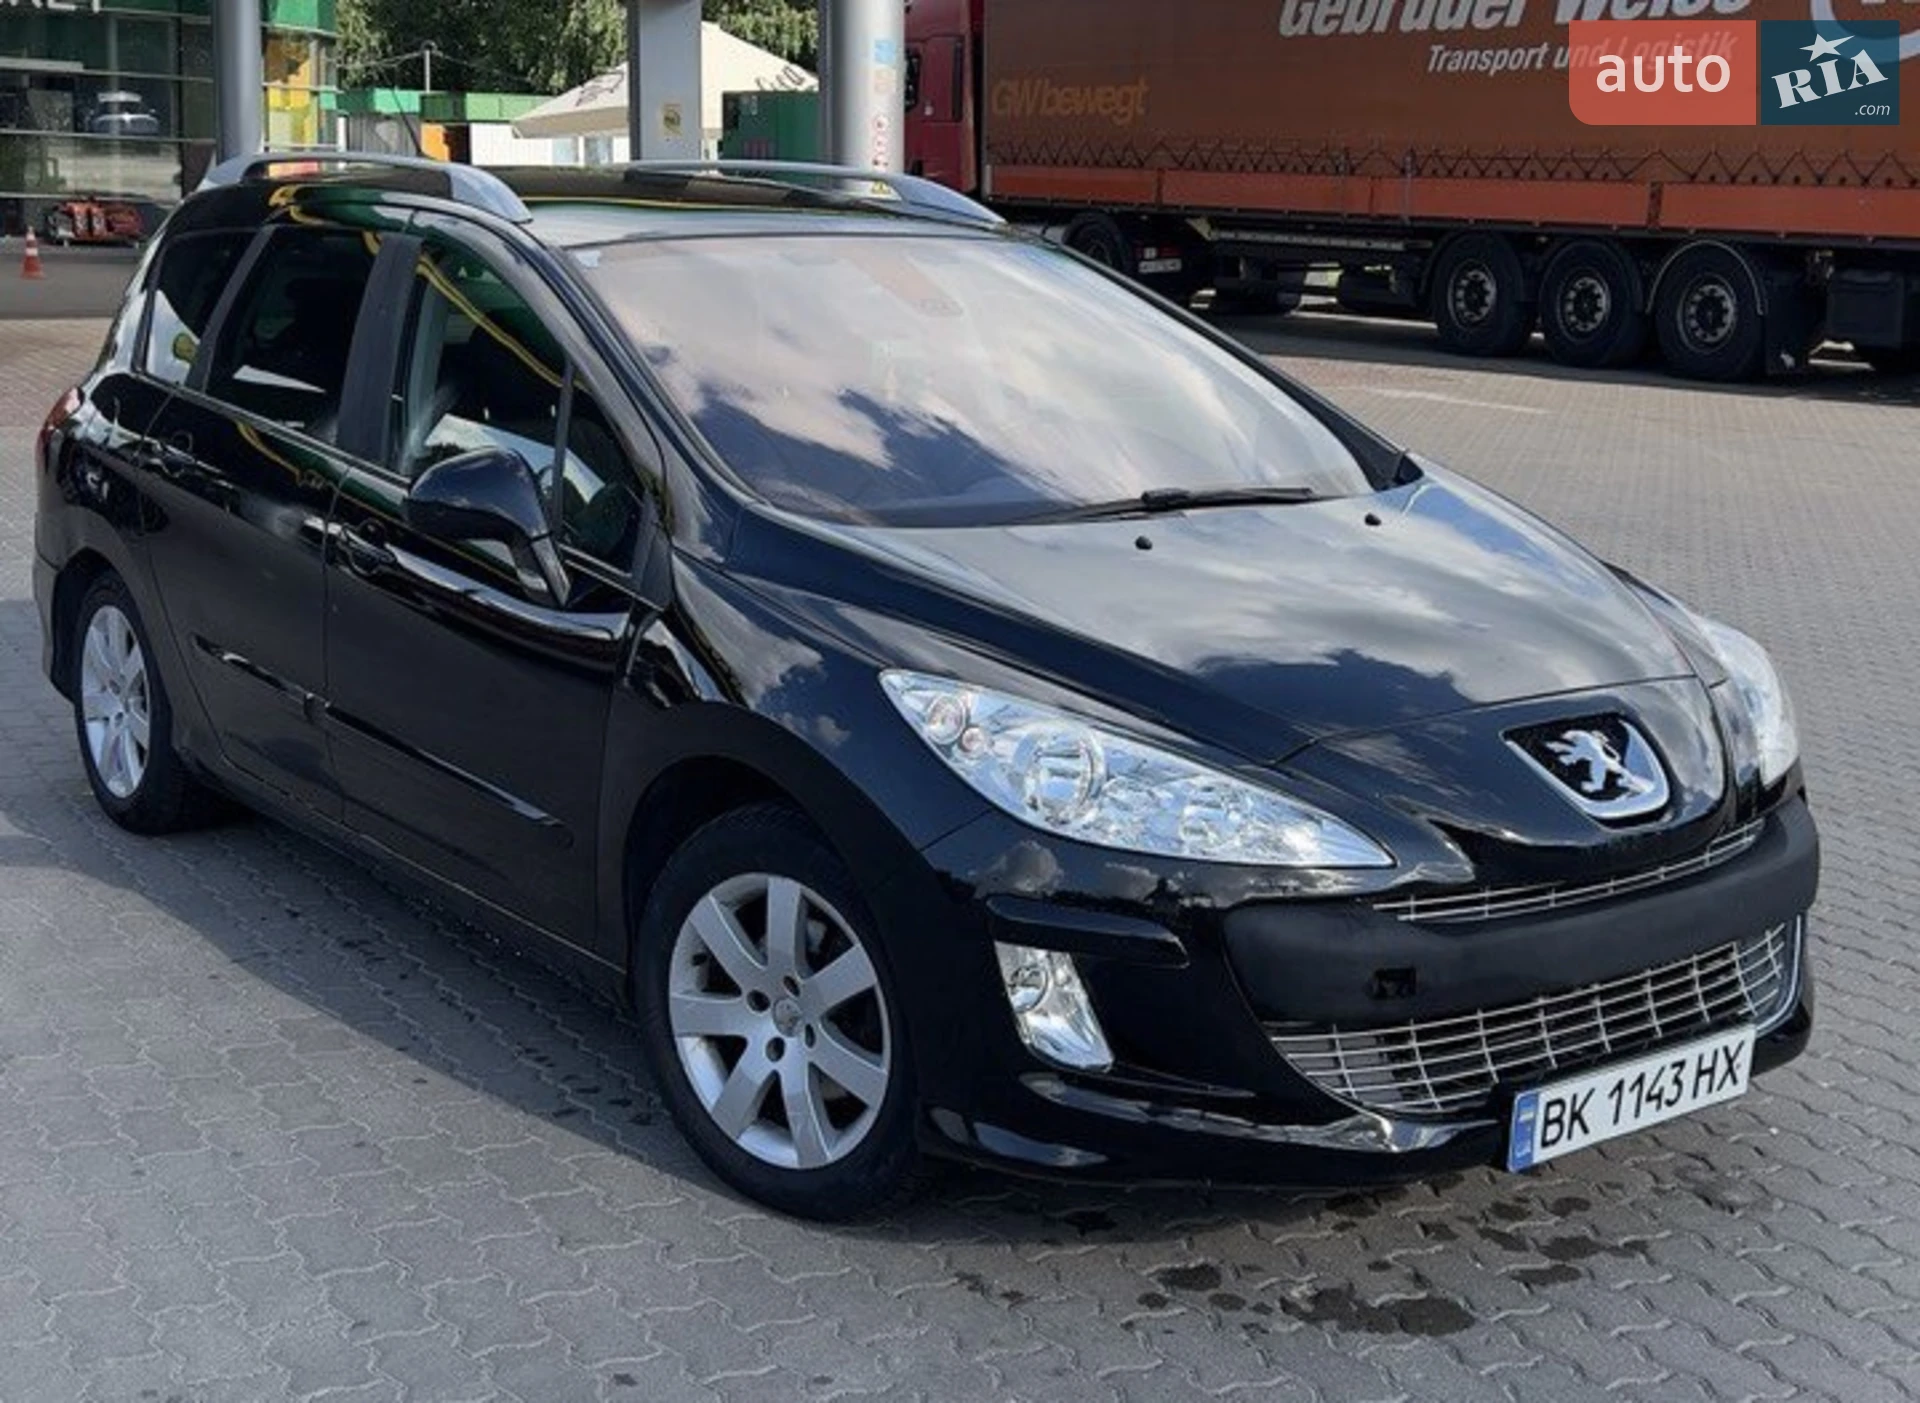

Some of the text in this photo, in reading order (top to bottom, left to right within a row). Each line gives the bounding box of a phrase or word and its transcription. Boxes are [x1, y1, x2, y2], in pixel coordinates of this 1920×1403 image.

[1427, 42, 1549, 76] Transport
[1541, 1040, 1745, 1148] BK 1143 HX
